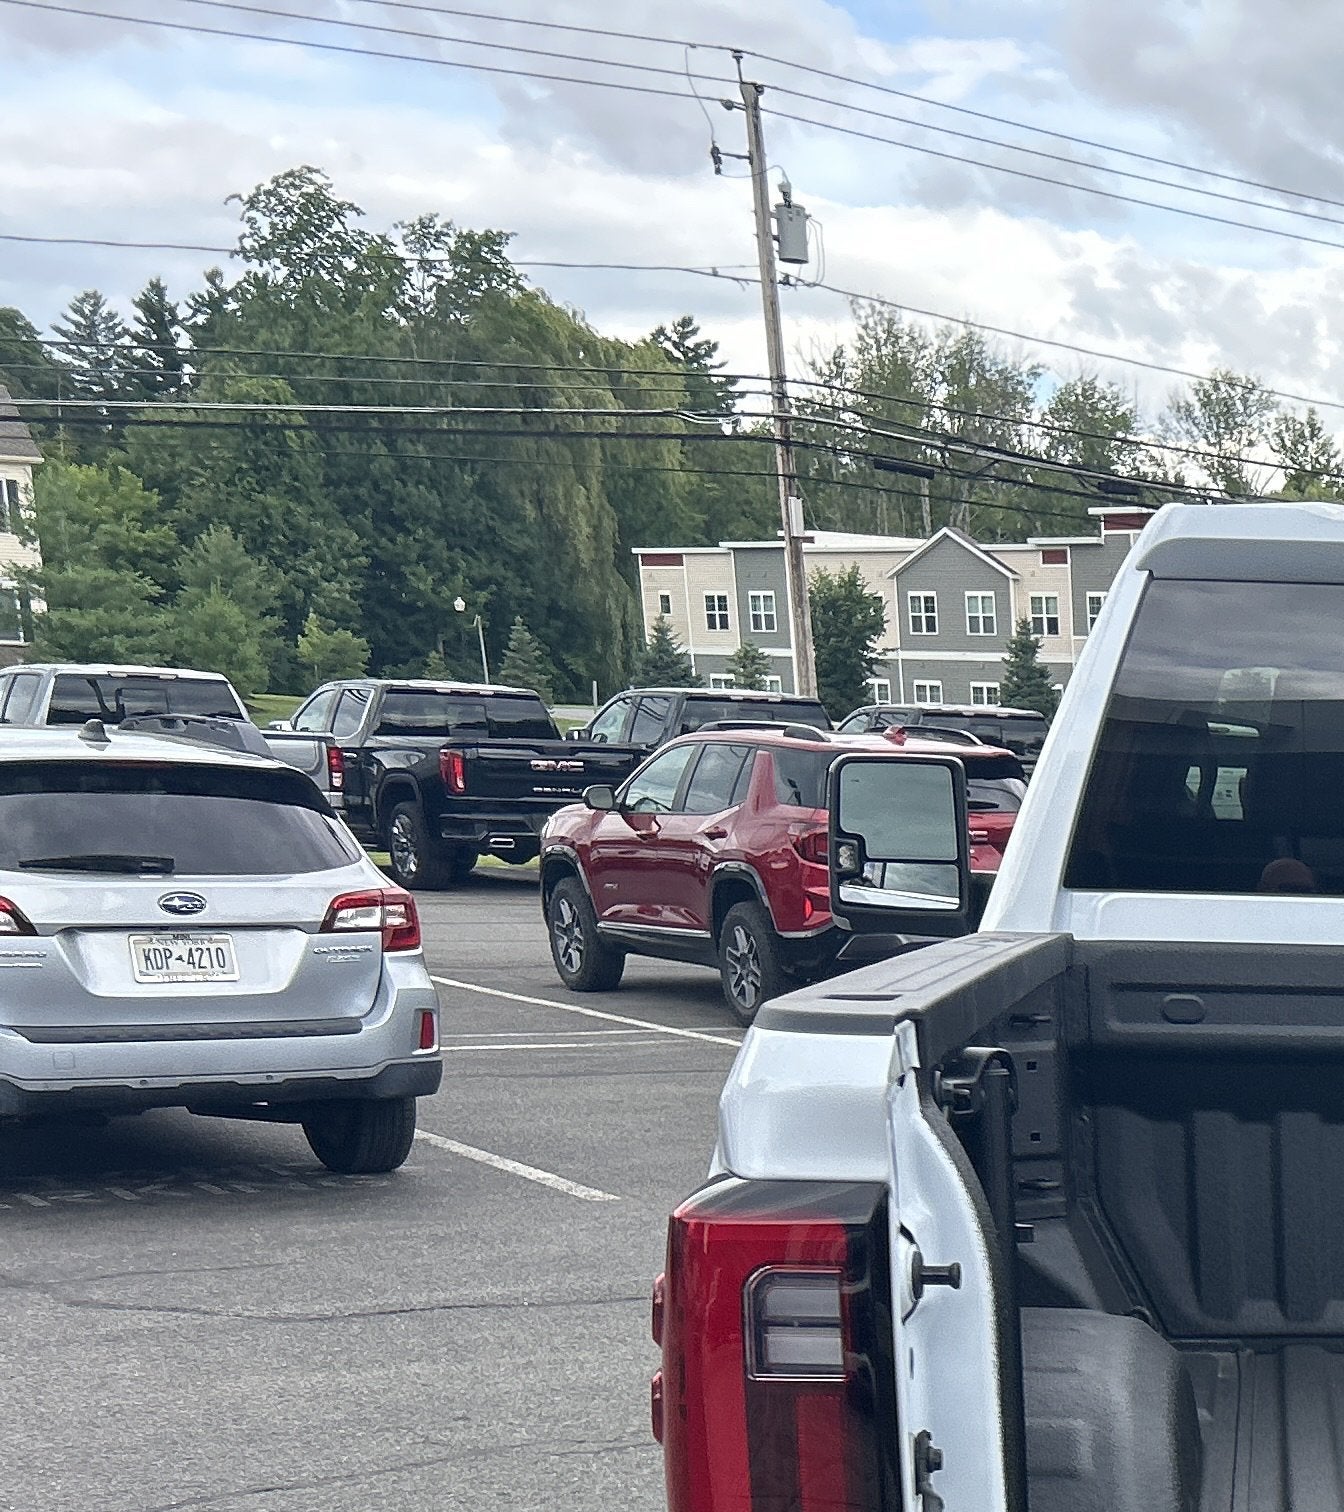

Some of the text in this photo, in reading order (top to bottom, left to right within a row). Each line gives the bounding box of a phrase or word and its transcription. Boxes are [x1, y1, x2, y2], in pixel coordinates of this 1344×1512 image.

[530, 759, 585, 772] GMC
[142, 947, 226, 971] KDP 4210
